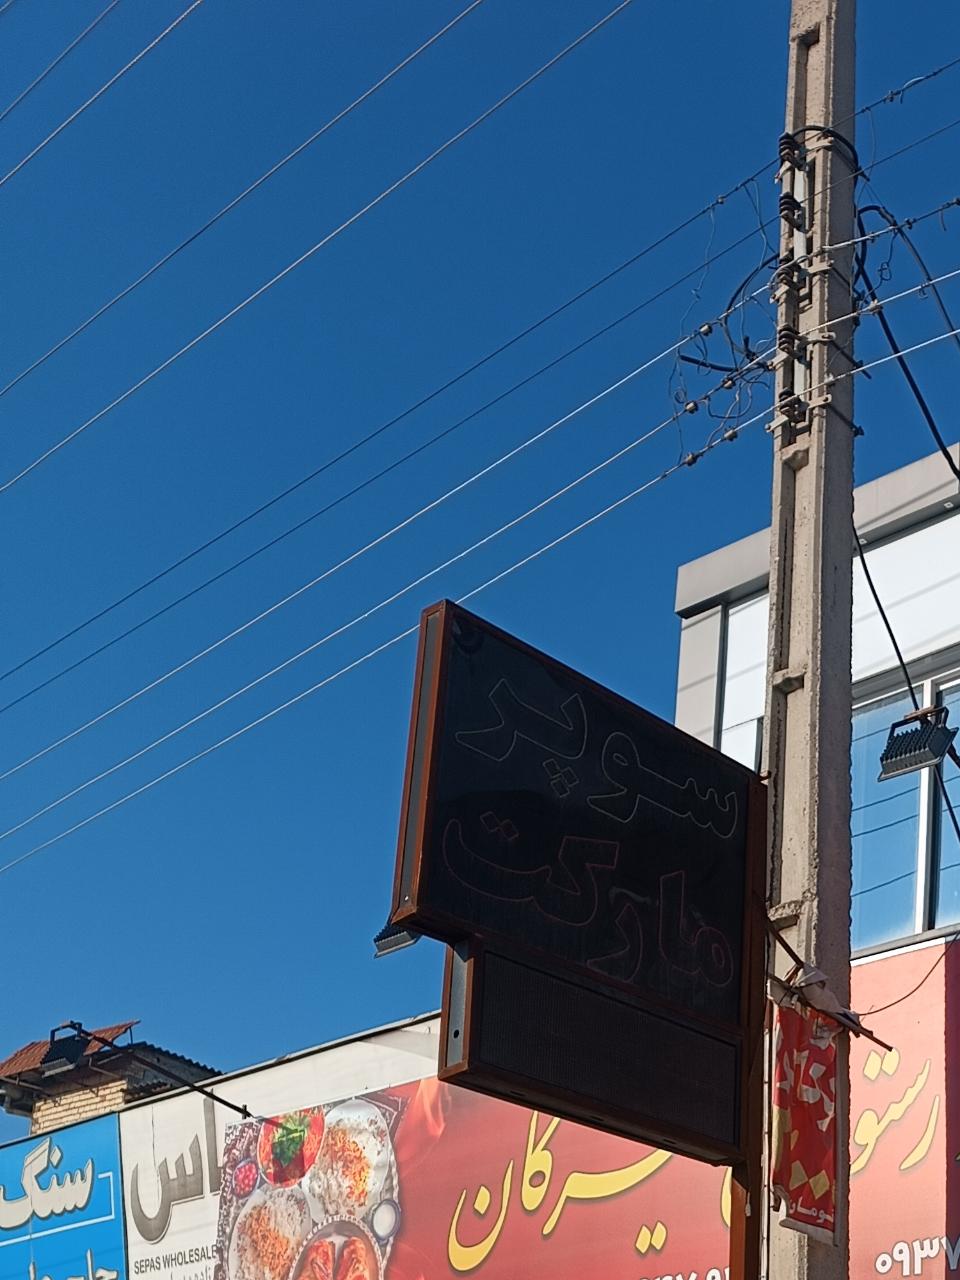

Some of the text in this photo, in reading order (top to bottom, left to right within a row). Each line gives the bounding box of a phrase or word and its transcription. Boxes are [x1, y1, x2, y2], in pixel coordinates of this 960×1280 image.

[455, 678, 738, 838] سوپر
[442, 810, 734, 989] مارکت
[134, 1256, 161, 1274] SEPAS
